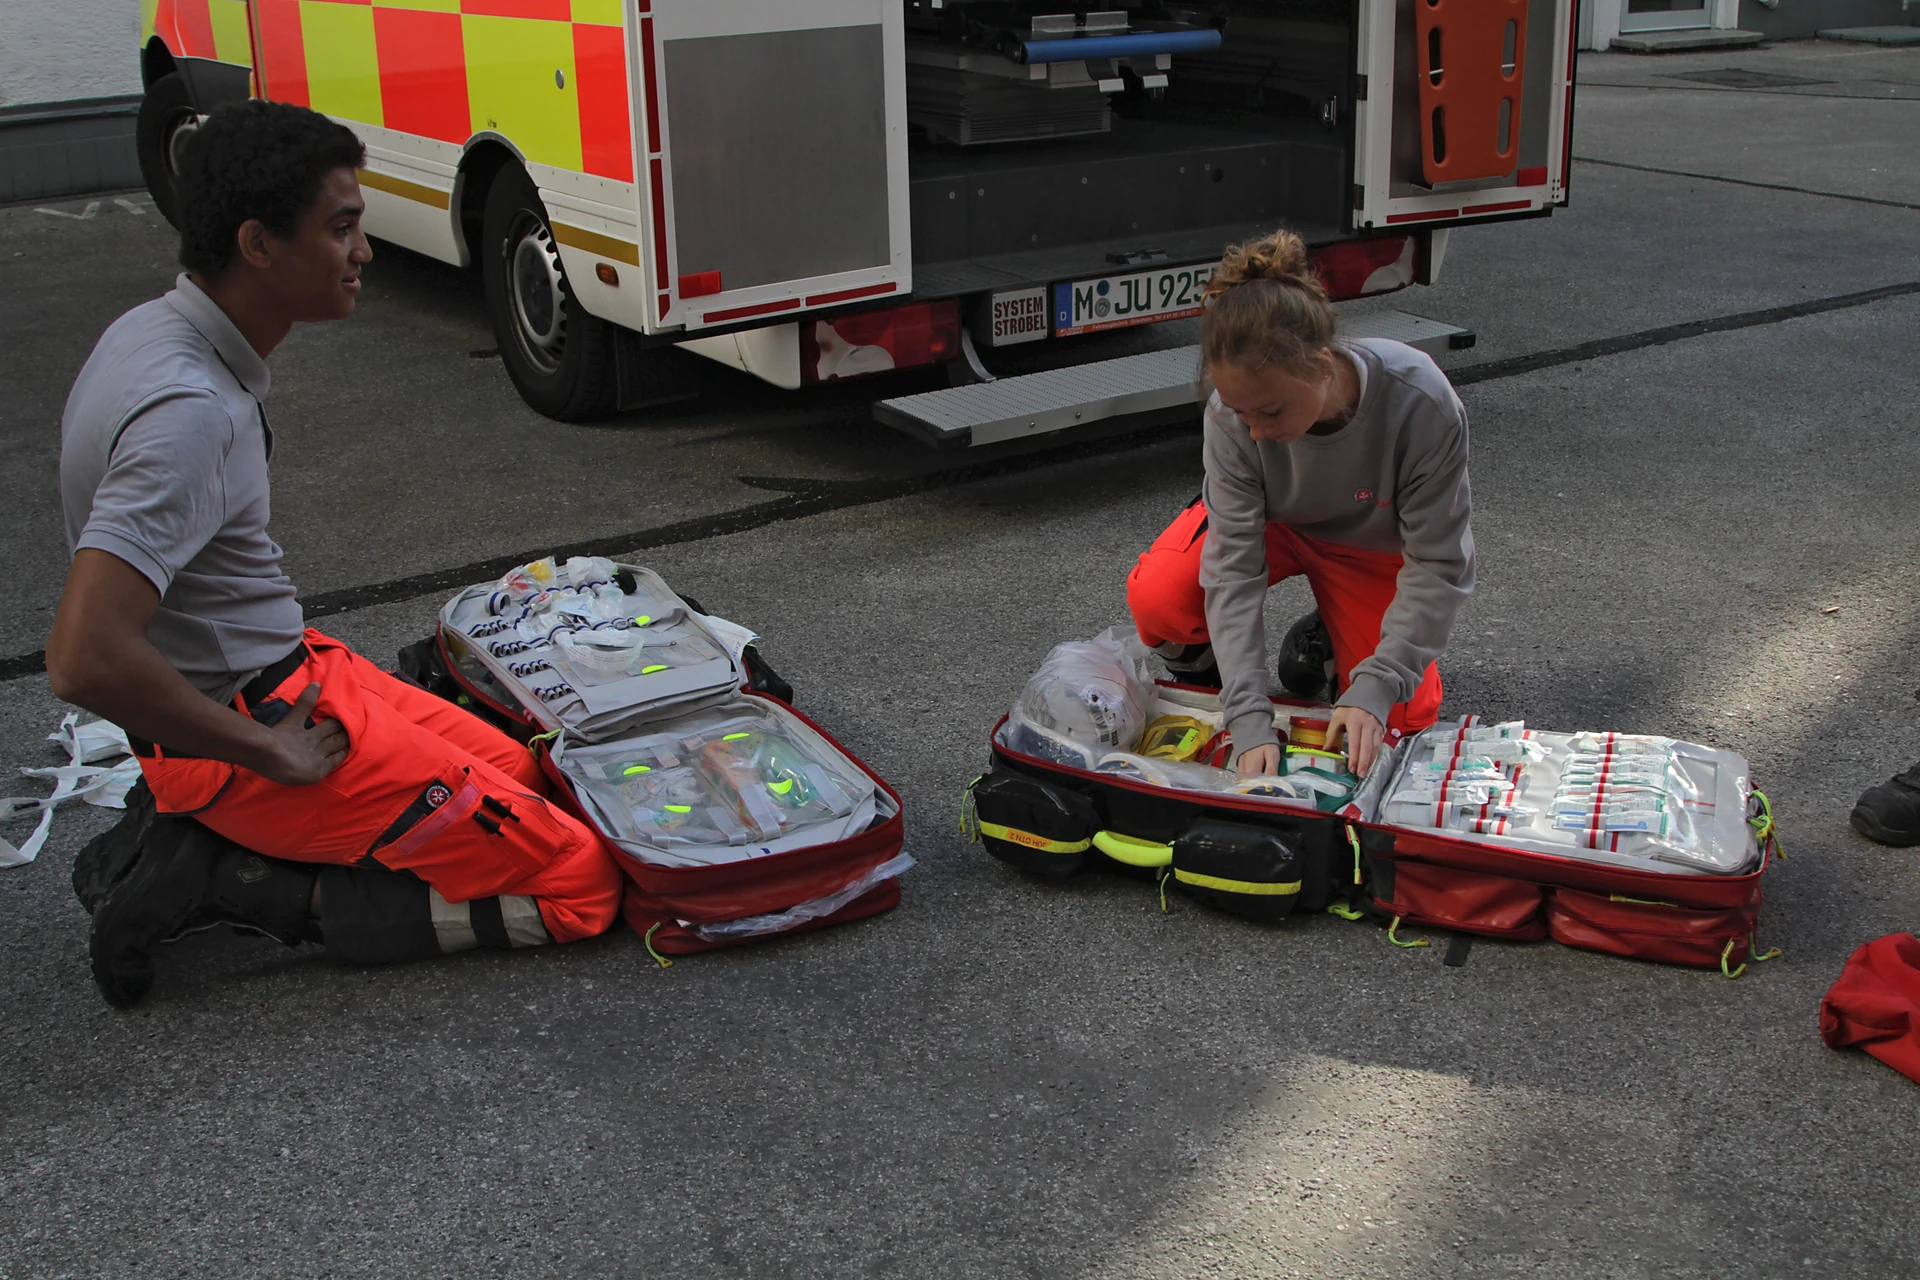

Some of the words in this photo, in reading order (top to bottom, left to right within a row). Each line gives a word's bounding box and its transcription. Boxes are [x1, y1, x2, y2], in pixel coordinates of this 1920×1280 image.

[1075, 285, 1093, 321] M
[1114, 277, 1151, 315] JU
[1159, 267, 1217, 308] 925
[994, 296, 1043, 319] SYSTEM
[1060, 311, 1067, 321] D
[994, 314, 1046, 337] STROBEL
[1009, 832, 1015, 840] 2
[1016, 834, 1031, 844] OTN
